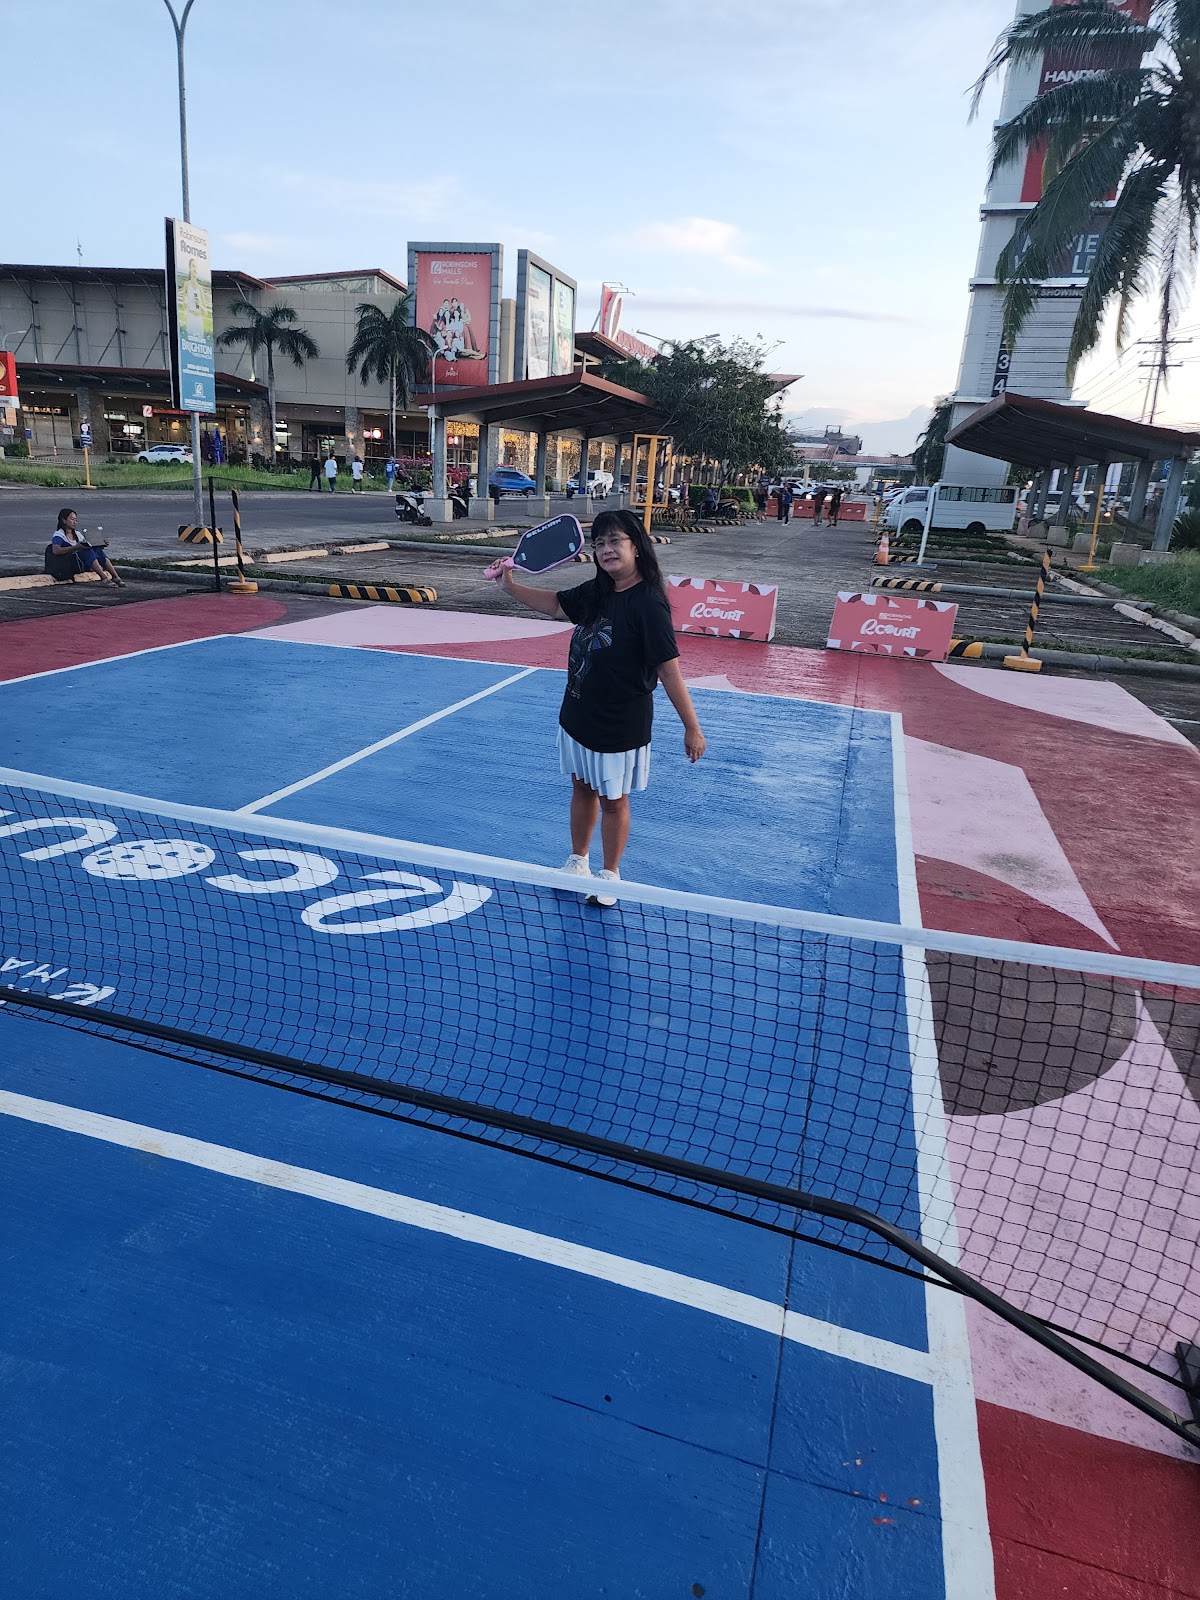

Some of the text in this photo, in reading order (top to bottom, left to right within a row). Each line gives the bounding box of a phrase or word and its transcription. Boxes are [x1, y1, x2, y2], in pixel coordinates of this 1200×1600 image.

[180, 226, 207, 247] Robinsons
[442, 261, 478, 269] ROBINSONS
[998, 354, 1010, 370] 3
[993, 378, 1006, 394] 4
[525, 517, 563, 539] SELKIRK
